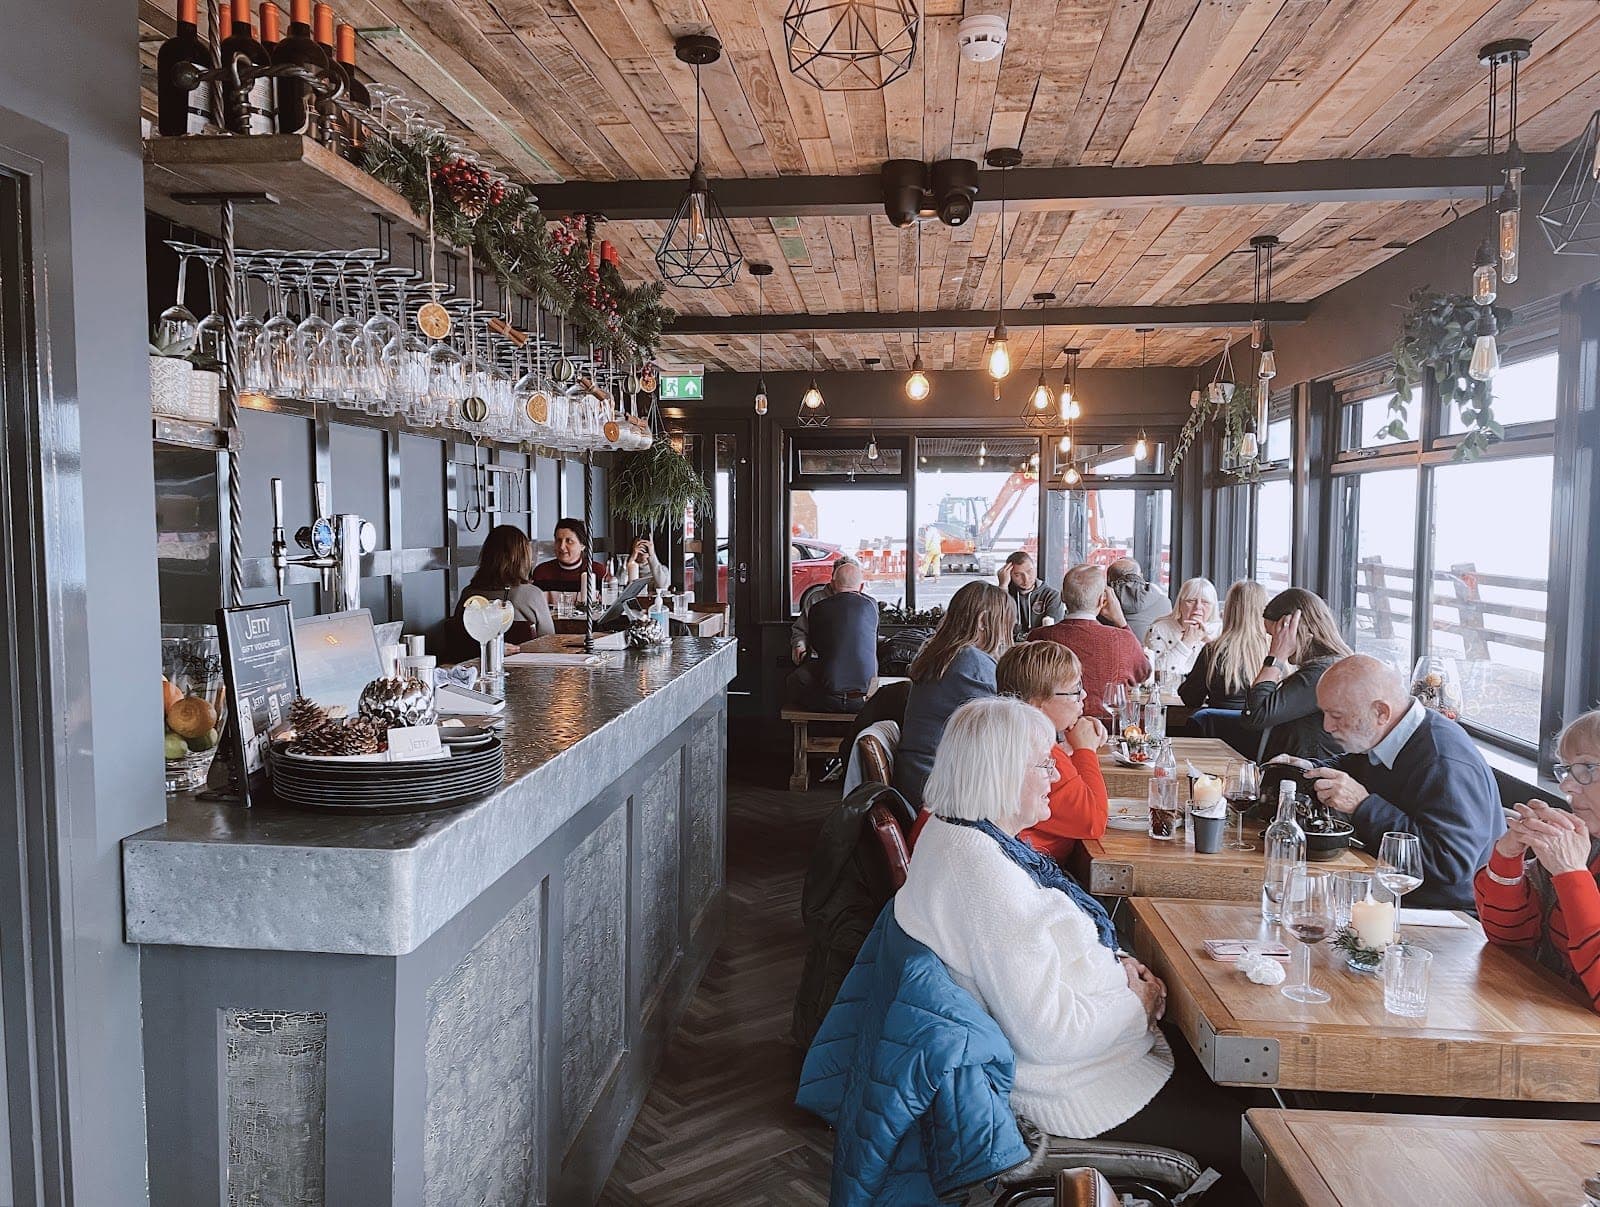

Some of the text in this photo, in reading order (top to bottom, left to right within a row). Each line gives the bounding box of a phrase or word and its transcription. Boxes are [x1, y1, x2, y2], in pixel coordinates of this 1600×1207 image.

[245, 614, 270, 640] JETTY
[241, 638, 281, 654] GIFT VOUCHERS
